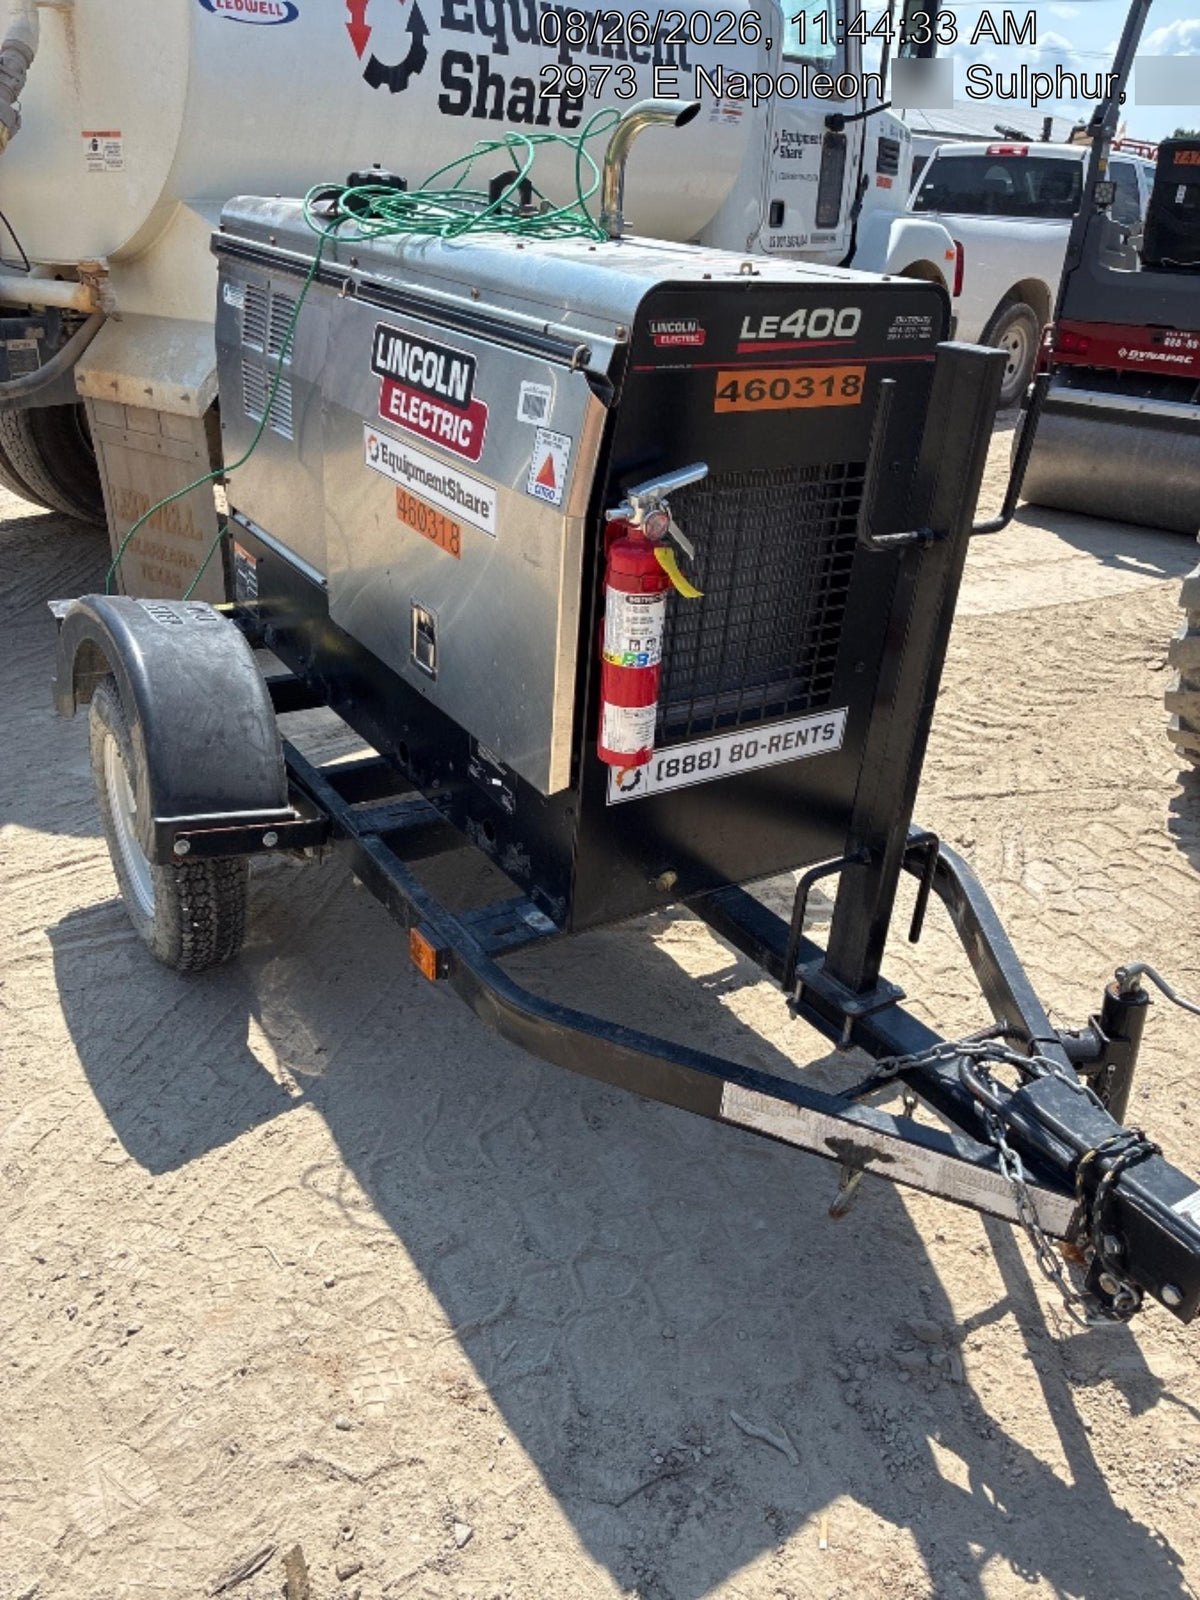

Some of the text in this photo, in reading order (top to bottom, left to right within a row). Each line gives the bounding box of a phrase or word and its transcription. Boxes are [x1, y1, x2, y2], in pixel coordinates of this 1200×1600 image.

[215, 0, 283, 16] LEDWELL
[438, 49, 584, 128] Share
[651, 320, 696, 333] LINCOLN
[740, 307, 862, 339] LE400
[375, 332, 471, 403] LINCOLN
[1128, 349, 1194, 364] DYNAPAC
[388, 386, 474, 447] ELECTRIC
[716, 374, 862, 403] 460318
[380, 442, 491, 519] EquipmentShare
[398, 489, 461, 556] 460318
[655, 722, 836, 782] (888) 80-RENTS
